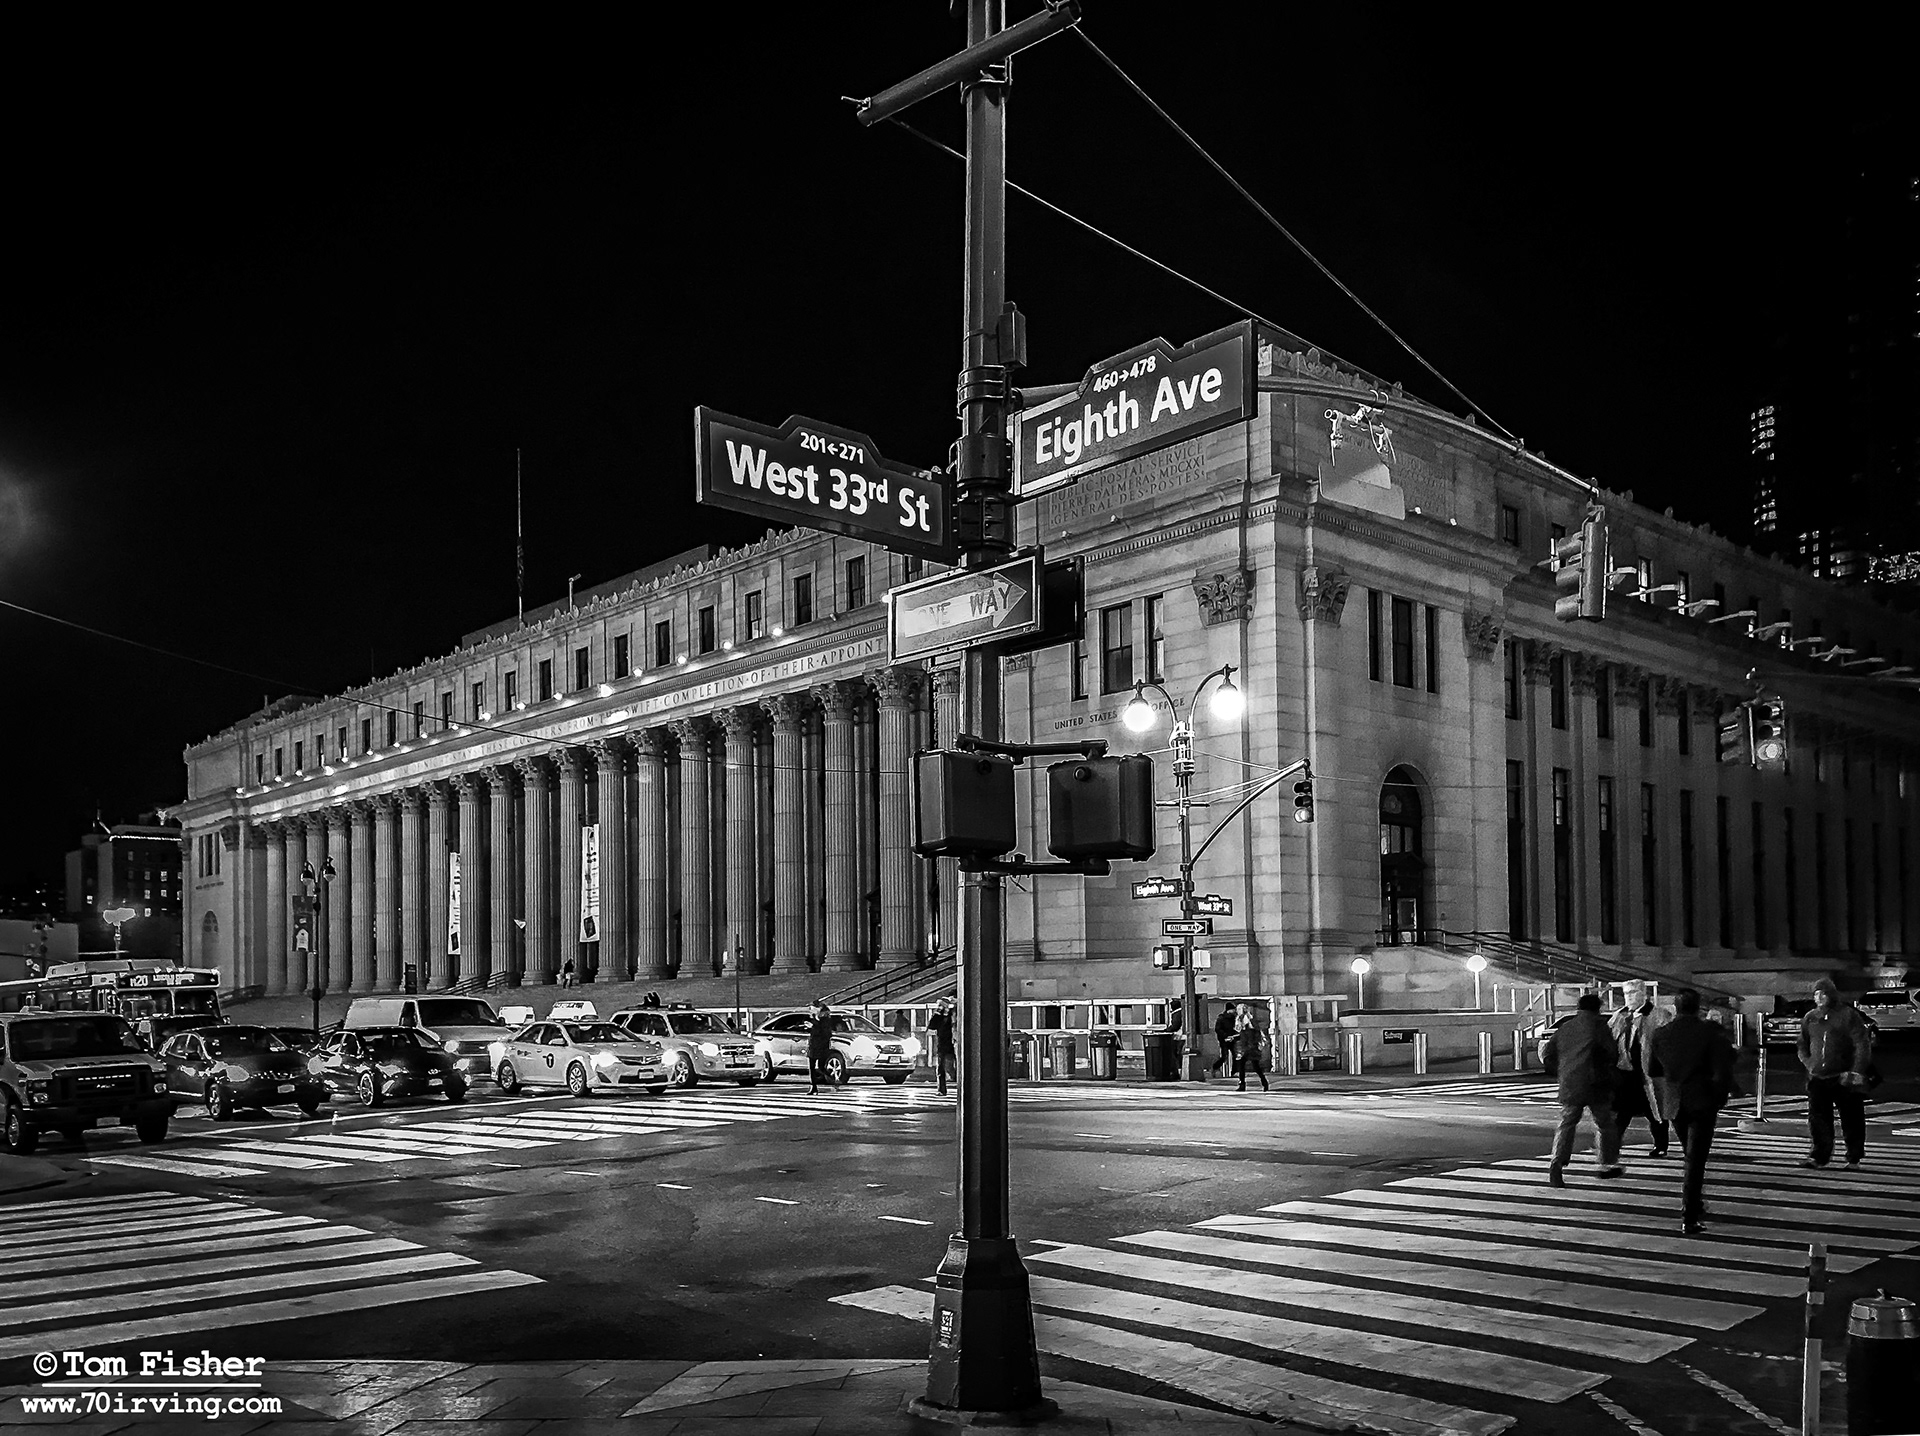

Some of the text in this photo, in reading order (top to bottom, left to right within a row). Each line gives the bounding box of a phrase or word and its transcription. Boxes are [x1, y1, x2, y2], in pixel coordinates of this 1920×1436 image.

[1093, 355, 1156, 393] 460 478
[1035, 367, 1223, 466] Eighth Ave
[800, 432, 864, 464] 201 271
[725, 439, 931, 532] West 33rd St
[1052, 479, 1094, 503] PUBLIC
[1052, 494, 1091, 514] PIERRE
[969, 584, 1012, 618] WAY
[626, 698, 659, 718] SWIFT
[664, 676, 745, 707] COMPLETION
[751, 670, 767, 684] OF
[772, 657, 815, 680] THEIR
[1054, 697, 1186, 730] UNITED STATES OFFCE
